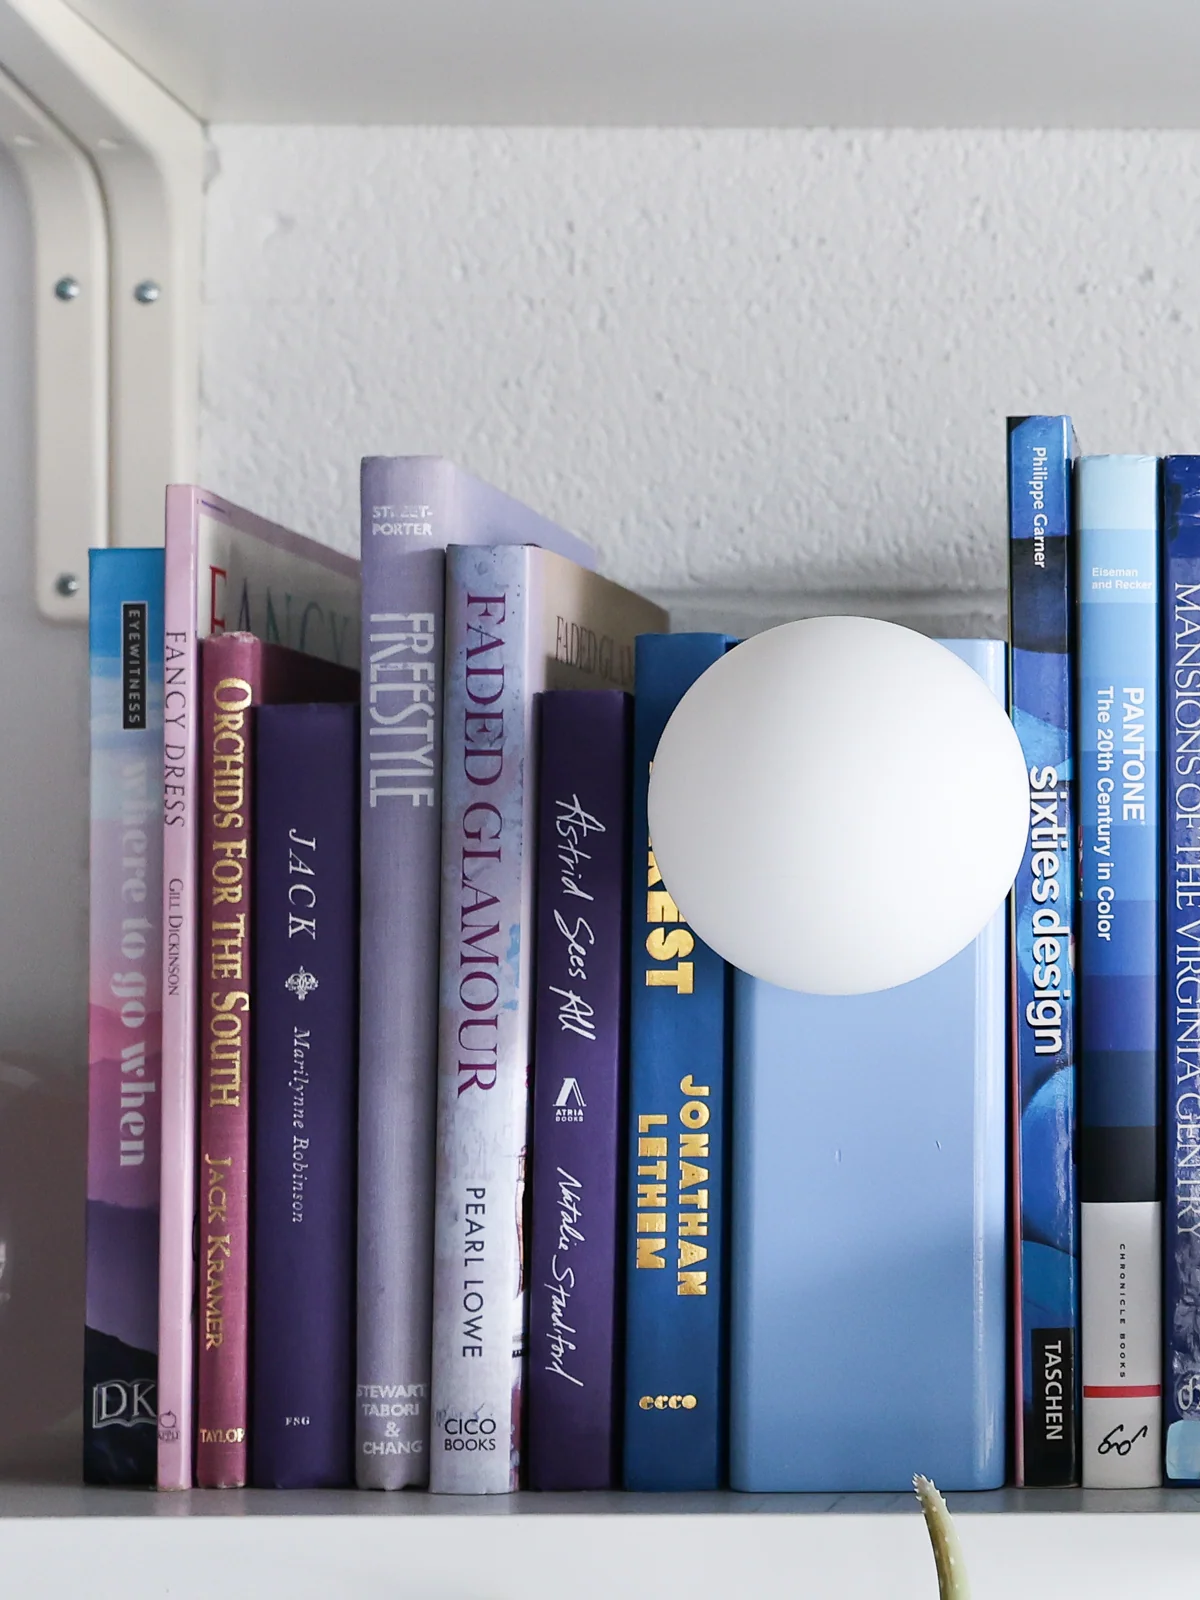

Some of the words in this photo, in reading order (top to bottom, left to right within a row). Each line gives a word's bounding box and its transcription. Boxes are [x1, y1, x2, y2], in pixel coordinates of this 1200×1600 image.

[372, 505, 433, 518] STET-
[1029, 447, 1047, 510] Philippe
[372, 522, 433, 536] PORTER
[1032, 514, 1048, 568] Garner
[1092, 567, 1138, 577] Eiseman
[1092, 580, 1112, 590] and
[1115, 580, 1152, 590] Recker
[128, 609, 141, 723] EYEWITNESS
[165, 631, 187, 730] FANCY
[463, 592, 506, 786] FADED
[1097, 686, 1114, 724] The
[370, 612, 434, 808] FREESTYLE
[164, 743, 186, 828] DRESS
[213, 677, 252, 830] ORCHIDS
[1097, 729, 1114, 771] 20th
[1122, 687, 1145, 822] PANTONE
[121, 757, 157, 903] where
[554, 794, 605, 902] Astrid
[1030, 765, 1067, 903] sixties
[1093, 777, 1115, 857] Century
[212, 839, 248, 905] FOR
[288, 828, 317, 940] JACK
[1097, 862, 1114, 881] in
[120, 915, 154, 961] to
[211, 913, 246, 979] THE
[458, 802, 503, 1098] GLAMOUR
[552, 908, 596, 980] Sees
[645, 835, 694, 994] EST
[1097, 886, 1114, 942] Color
[168, 915, 183, 996] DICKINSON
[1026, 909, 1070, 1054] design
[110, 970, 148, 1029] go
[549, 984, 596, 1042] All
[211, 990, 250, 1108] SOUTH
[289, 1026, 311, 1128] Marilynne
[119, 1041, 156, 1167] when
[205, 1154, 232, 1224] JACK
[292, 1135, 309, 1223] Robinson
[557, 1166, 584, 1252] Natalie
[636, 1114, 668, 1269] LETHEM
[677, 1074, 710, 1295] JONATHAN
[465, 1187, 485, 1268] PEARL
[206, 1234, 231, 1351] KRAMER
[463, 1280, 483, 1358] LOWE
[545, 1255, 584, 1387] Standiford
[100, 1383, 157, 1421] DK
[285, 1416, 310, 1426] FSG
[357, 1384, 425, 1398] STEWART
[362, 1404, 419, 1416] TABORI
[384, 1421, 400, 1437] &
[444, 1418, 497, 1434] CICO
[638, 1395, 697, 1410] ecco
[1044, 1340, 1063, 1440] TASCHEN
[362, 1440, 422, 1454] CHANG
[444, 1438, 496, 1451] BOOKS
